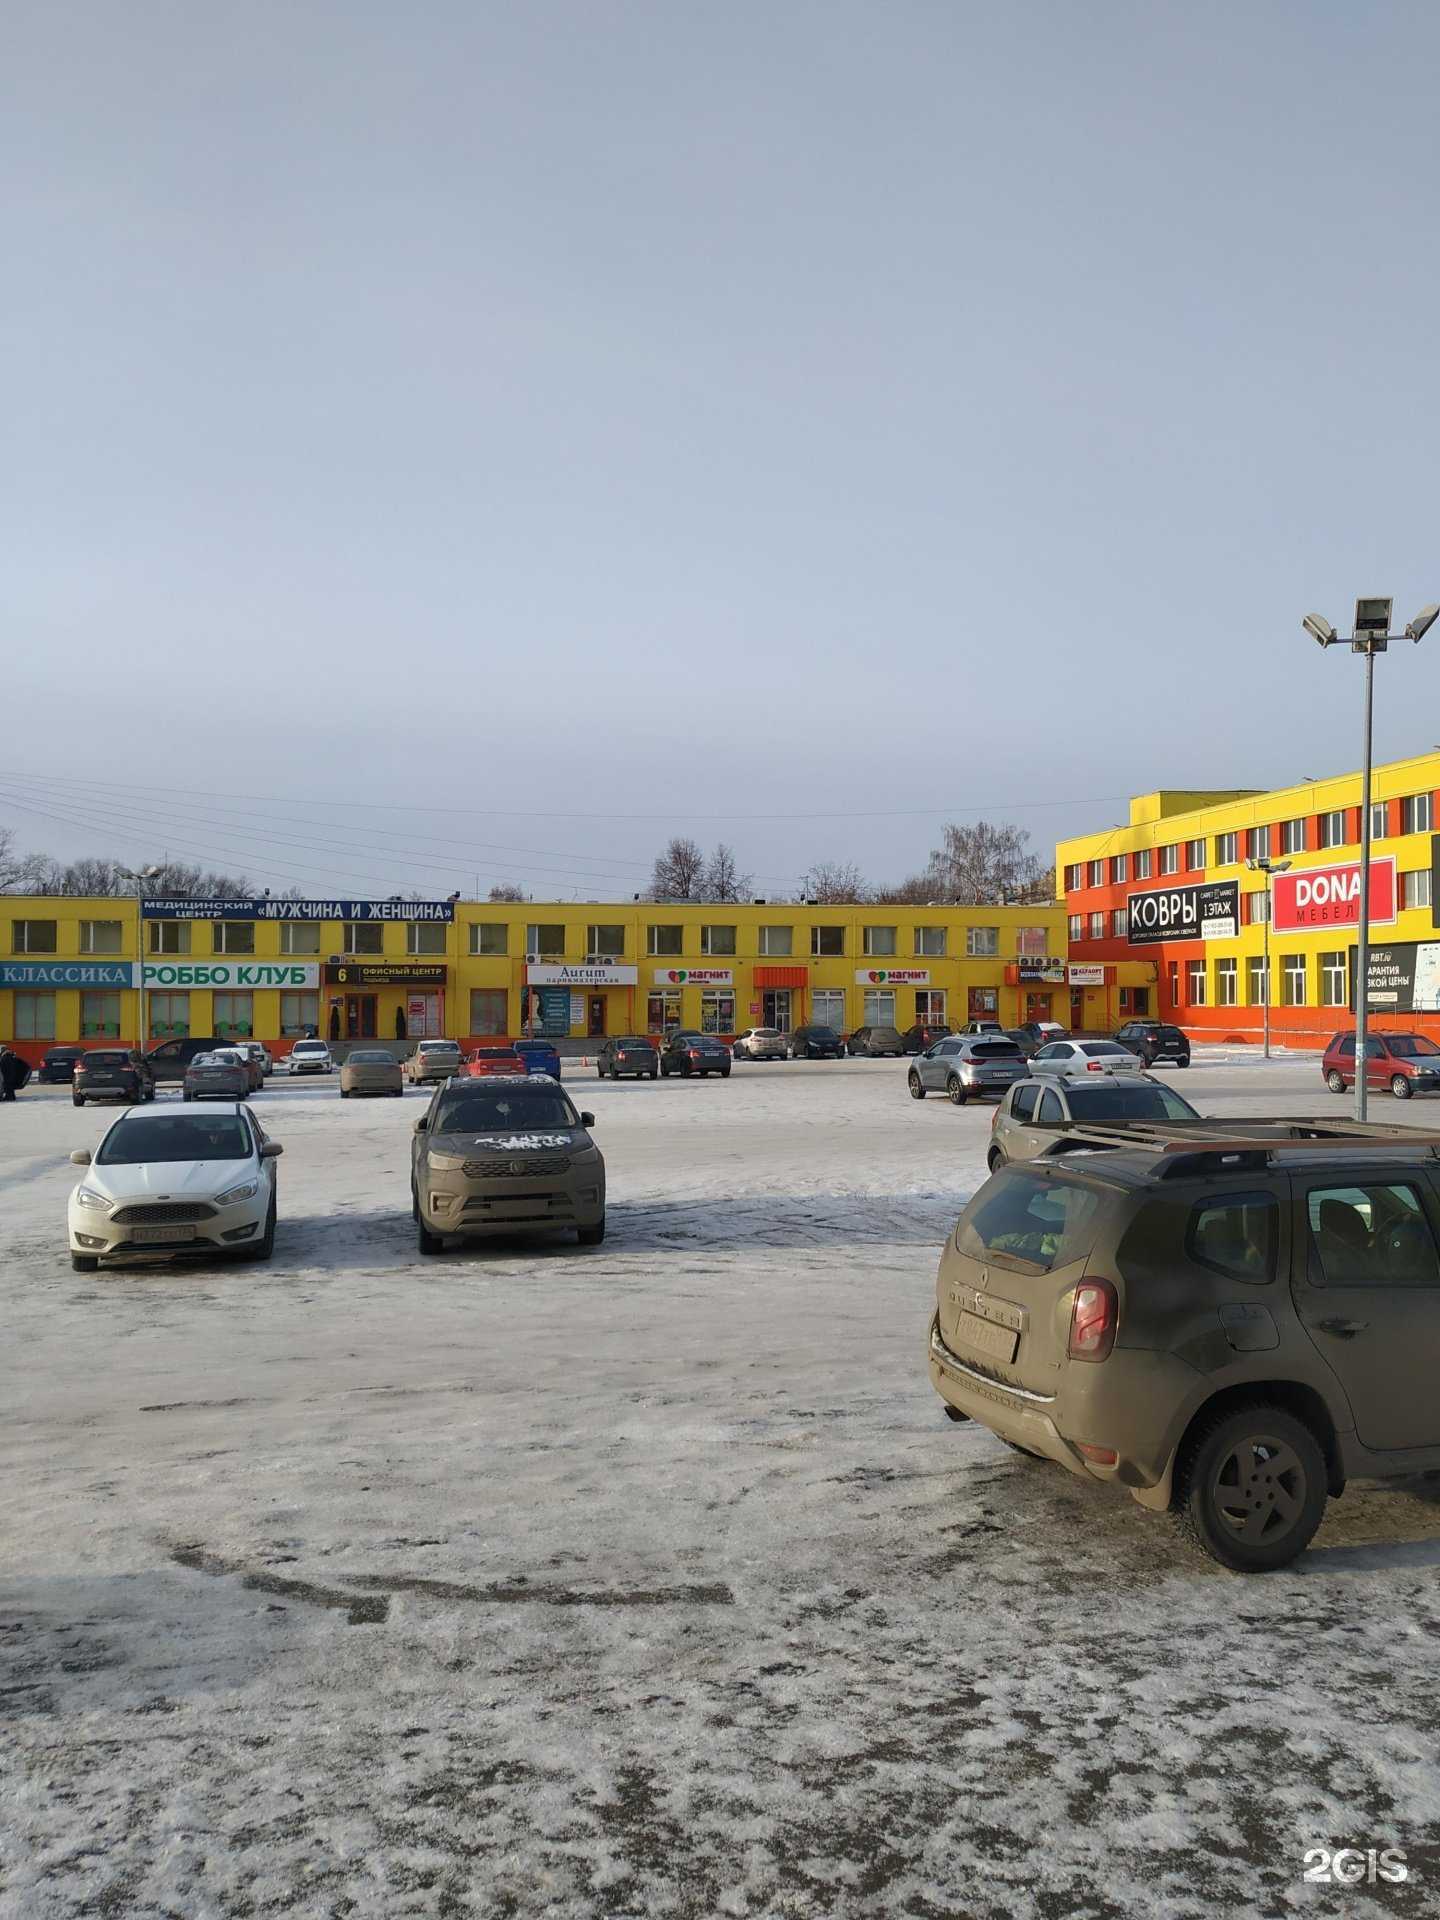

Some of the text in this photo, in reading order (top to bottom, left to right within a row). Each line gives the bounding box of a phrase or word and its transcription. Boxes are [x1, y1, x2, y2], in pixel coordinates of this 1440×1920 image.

[1296, 872, 1361, 907] DONA
[144, 901, 253, 910] МЕДИЦИНСКИЙ
[257, 902, 452, 920] «МУЖЧИНА И ЖЕНЩИНА»
[1131, 892, 1197, 928] КОВРЫ
[1203, 901, 1232, 917] 1 ЭТАЖ
[175, 910, 223, 918] ЦЕНТР
[1296, 904, 1355, 923] МЕБЕЛ
[4, 967, 127, 983] КЛАССИКА
[142, 966, 307, 985] РОББО КЛУБ
[338, 968, 347, 982] 6
[362, 967, 442, 976] ОФИСНЫЙ ЦЕНТР
[560, 967, 606, 978] Aurum
[1367, 966, 1400, 976] АРАНТИЯ
[1367, 975, 1410, 988] ЗКОЙ ЦЕНЫ
